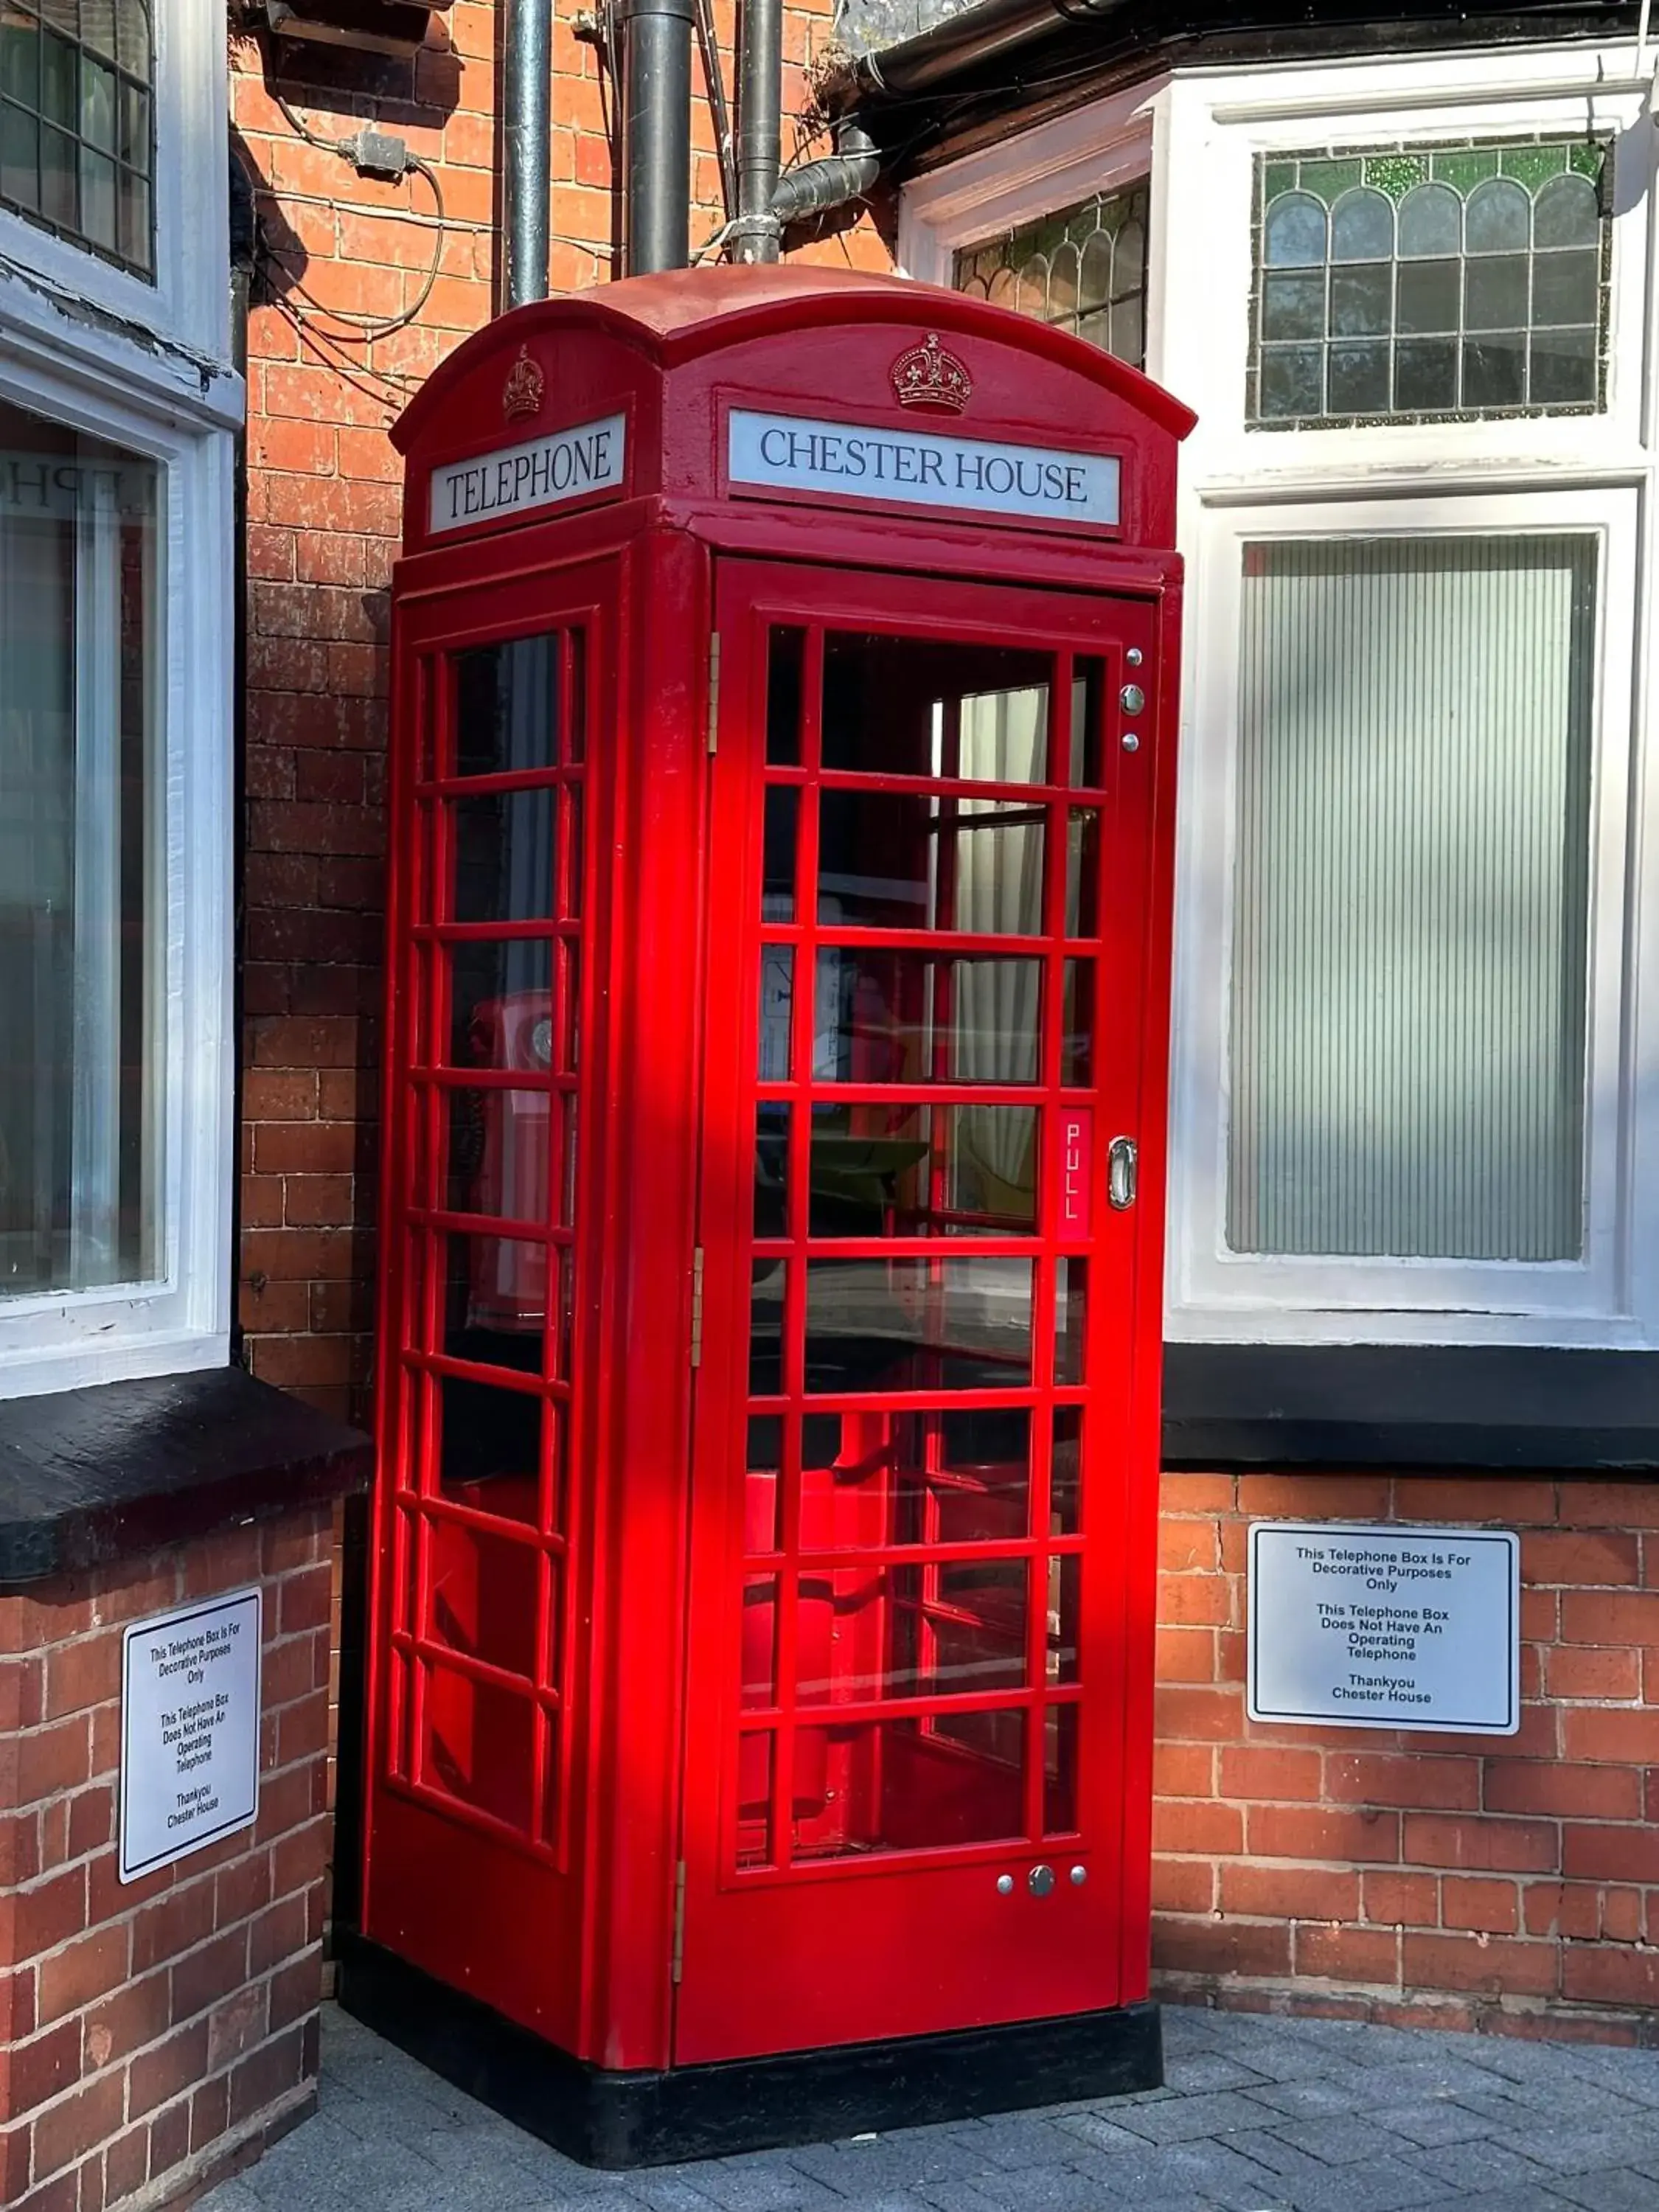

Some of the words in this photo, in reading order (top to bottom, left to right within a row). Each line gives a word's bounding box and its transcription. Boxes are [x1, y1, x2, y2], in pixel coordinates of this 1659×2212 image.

[447, 431, 612, 519] TELEPHONE
[760, 429, 947, 486] CHESTER
[956, 453, 1088, 503] HOUSE
[1065, 1124, 1080, 1219] PULL
[1296, 1548, 1324, 1559] This
[1328, 1548, 1397, 1564] Telephone
[1402, 1552, 1427, 1564] Box
[1432, 1554, 1443, 1564] Is
[1448, 1554, 1472, 1565] For
[1312, 1562, 1383, 1576] Decorative
[1388, 1565, 1452, 1579] Purposes
[1366, 1577, 1397, 1593] Only
[1317, 1604, 1345, 1615] This
[1349, 1604, 1418, 1619] Telephone
[1422, 1608, 1450, 1620] Box
[1321, 1618, 1354, 1630] Does
[1360, 1620, 1382, 1631] Not
[1387, 1621, 1419, 1633] Have
[1424, 1623, 1442, 1634] An
[150, 1646, 167, 1662] This
[168, 1636, 205, 1656] Telephone
[206, 1630, 220, 1644] Box
[220, 1626, 227, 1639] Is
[228, 1623, 240, 1636] For
[1349, 1632, 1415, 1649] Operating
[159, 1655, 198, 1677] Decorative
[198, 1644, 231, 1663] Purposes
[1347, 1646, 1416, 1660] Telephone
[188, 1668, 204, 1683] Only
[1349, 1674, 1415, 1689] Thankyou
[1332, 1687, 1384, 1701] Chester
[1388, 1690, 1431, 1703] House
[161, 1711, 176, 1728] This
[178, 1700, 214, 1720] Telephone
[215, 1694, 229, 1707] Box
[163, 1728, 181, 1745] Does
[183, 1722, 196, 1737] Not
[197, 1716, 214, 1731] Have
[215, 1710, 226, 1724] An
[177, 1733, 212, 1756] Operating
[177, 1750, 212, 1774] Telephone
[177, 1784, 211, 1807] Thankyou
[167, 1808, 195, 1829] Chester
[197, 1798, 218, 1816] House
